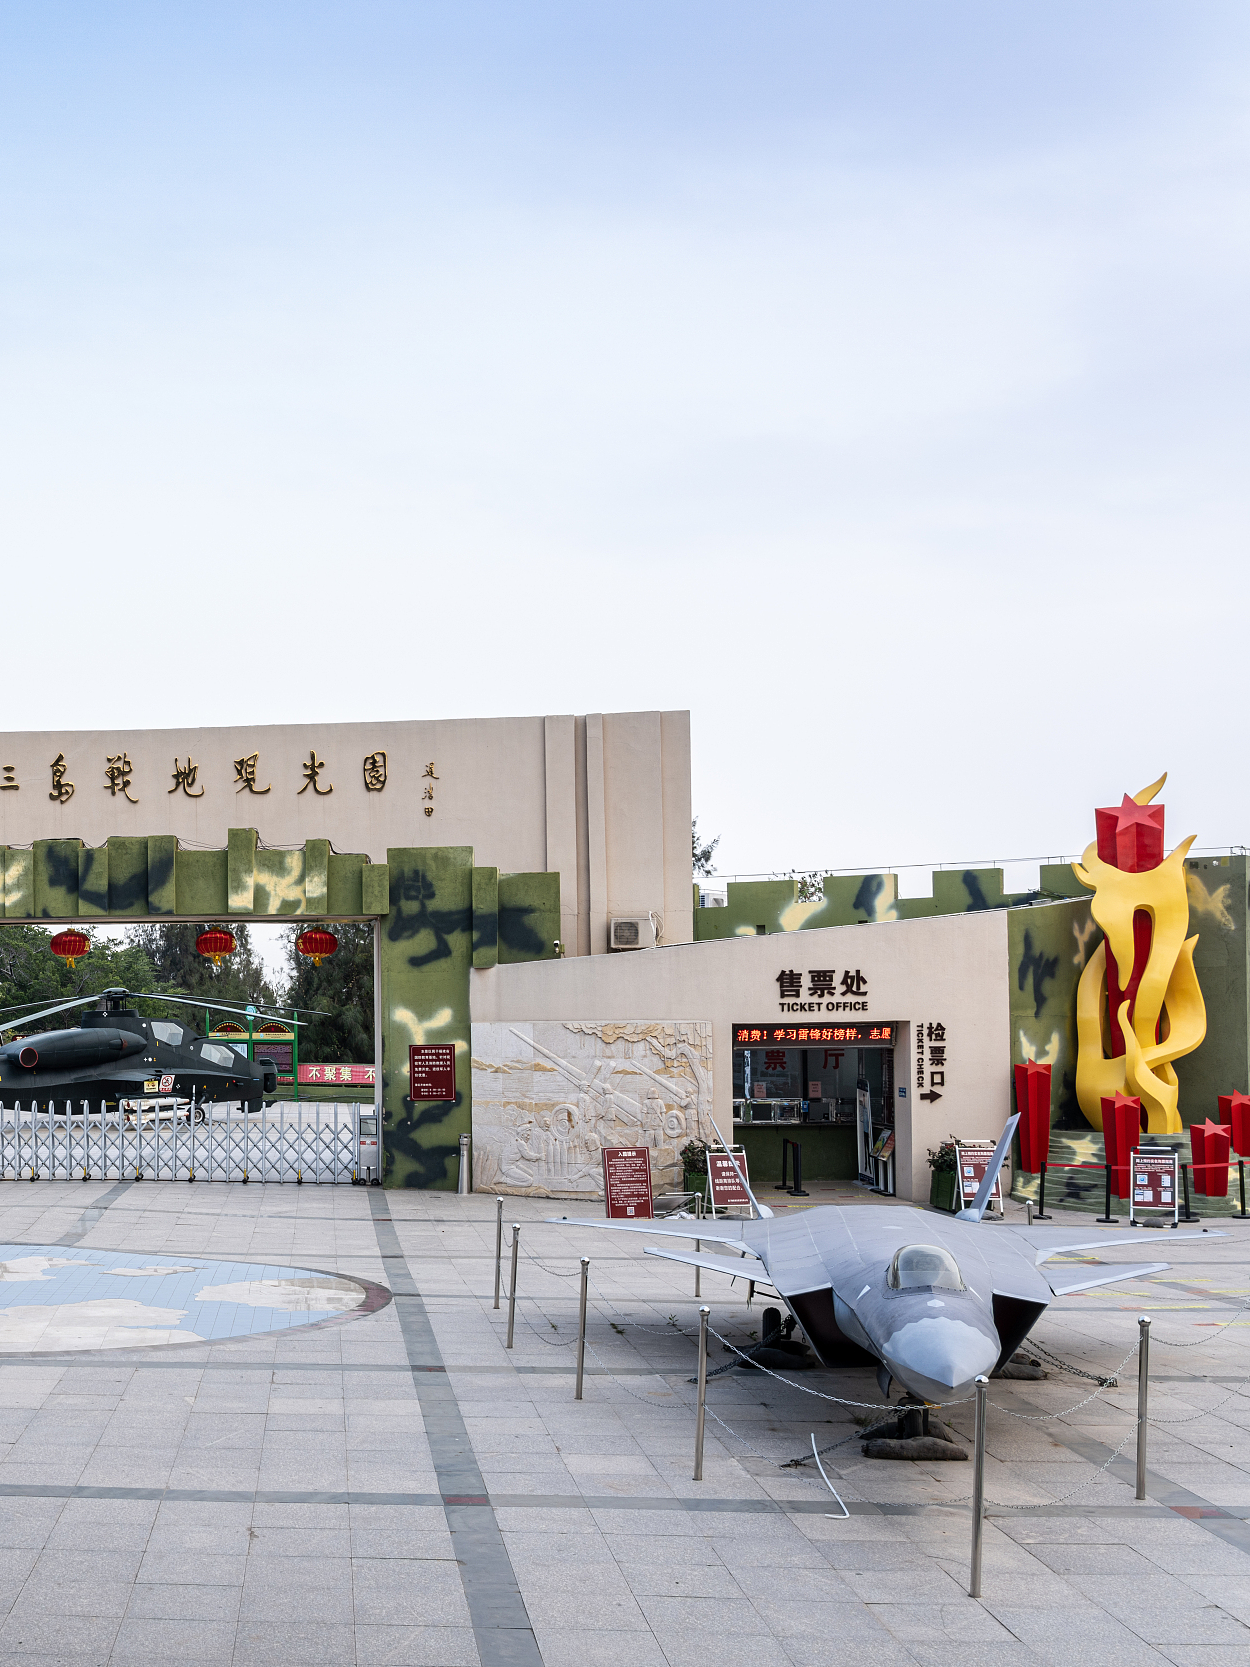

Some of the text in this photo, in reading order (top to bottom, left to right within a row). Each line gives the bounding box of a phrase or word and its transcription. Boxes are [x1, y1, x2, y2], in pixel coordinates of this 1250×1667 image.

[776, 969, 869, 999] 售票处
[779, 1001, 869, 1012] TICKET OFFICE
[916, 1023, 925, 1088] TICKET CHECK
[927, 1022, 947, 1087] 检票口
[308, 1066, 352, 1081] 不聚集
